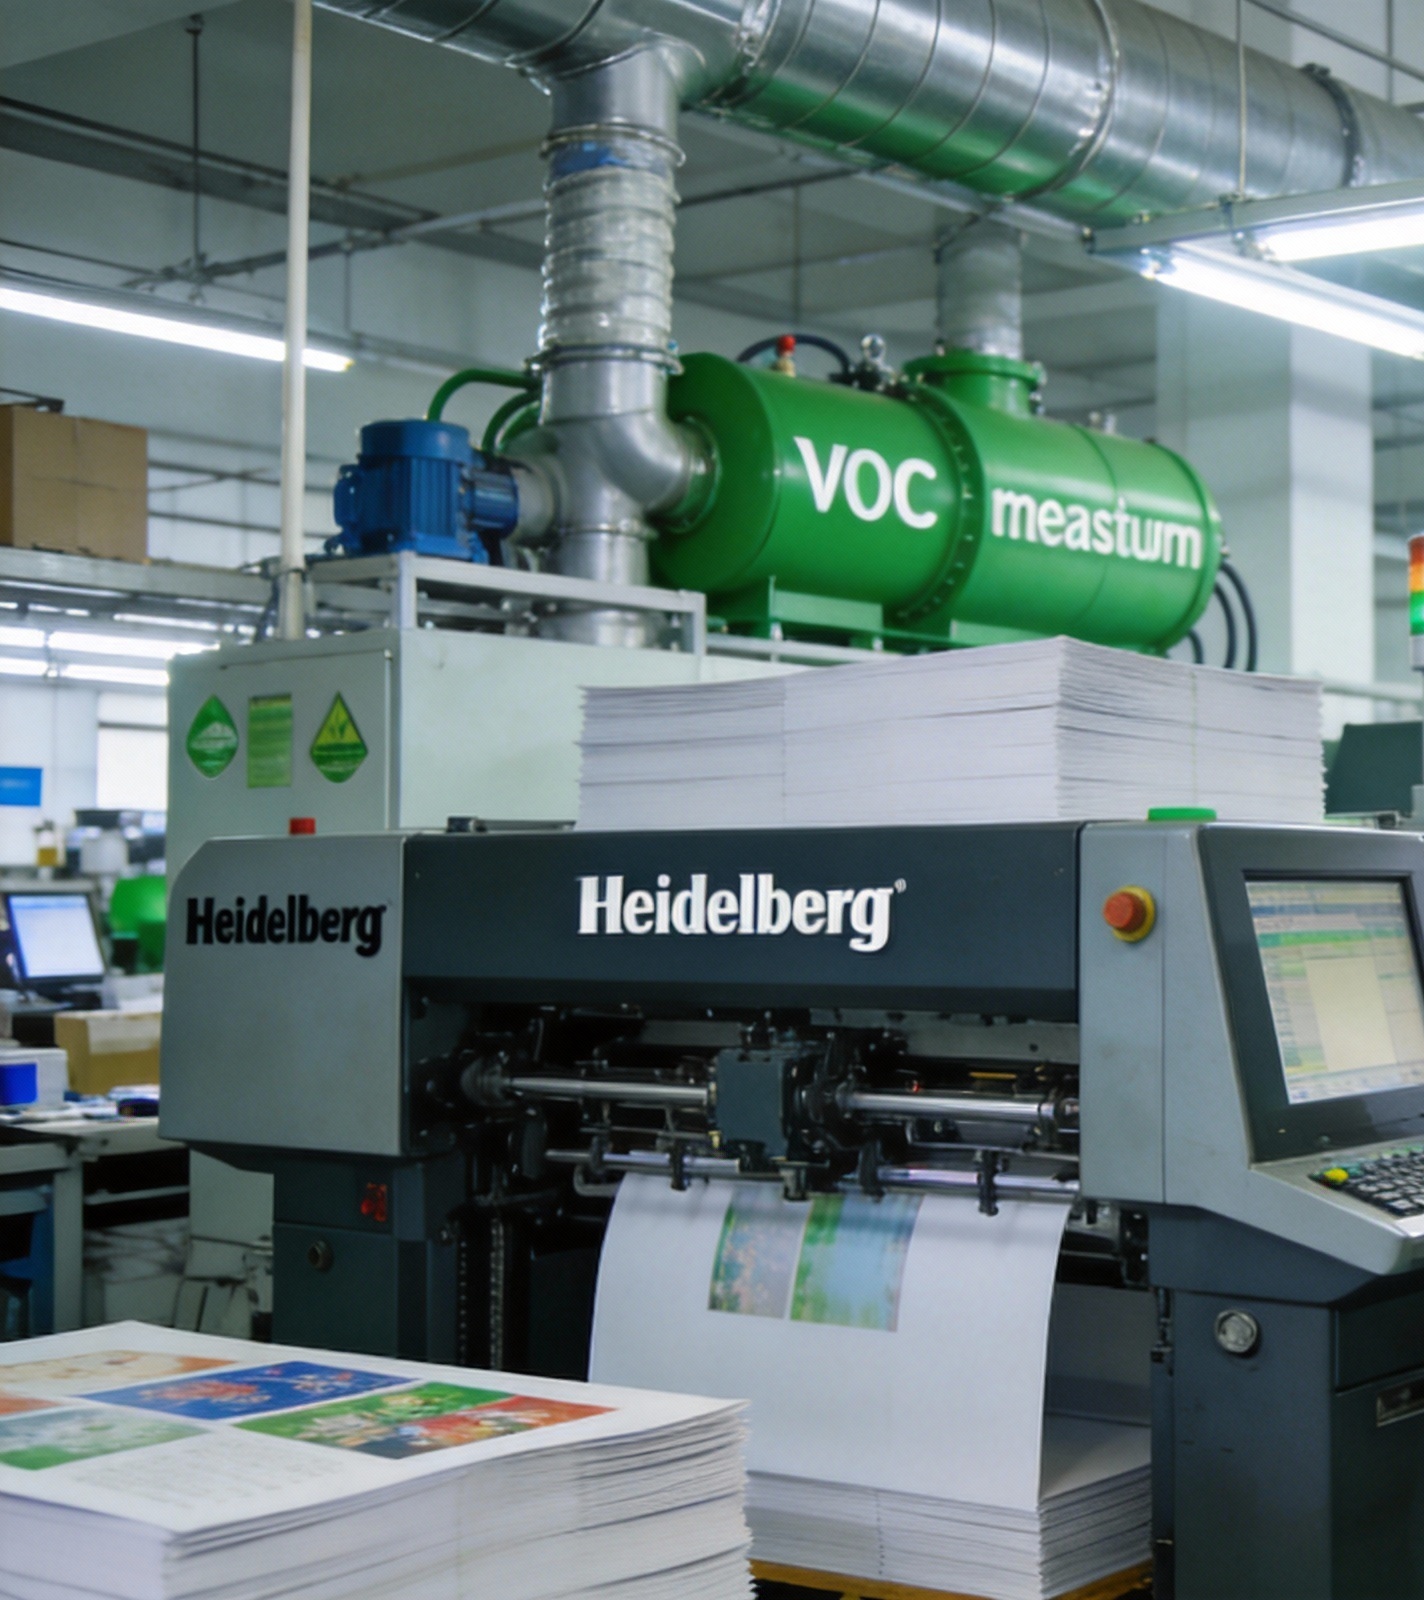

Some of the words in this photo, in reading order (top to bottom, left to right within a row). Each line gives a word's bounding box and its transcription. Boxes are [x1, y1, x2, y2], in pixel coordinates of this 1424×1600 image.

[793, 436, 938, 529] VOC
[186, 894, 387, 958] Heidelberg
[578, 873, 895, 952] Heidelberg
